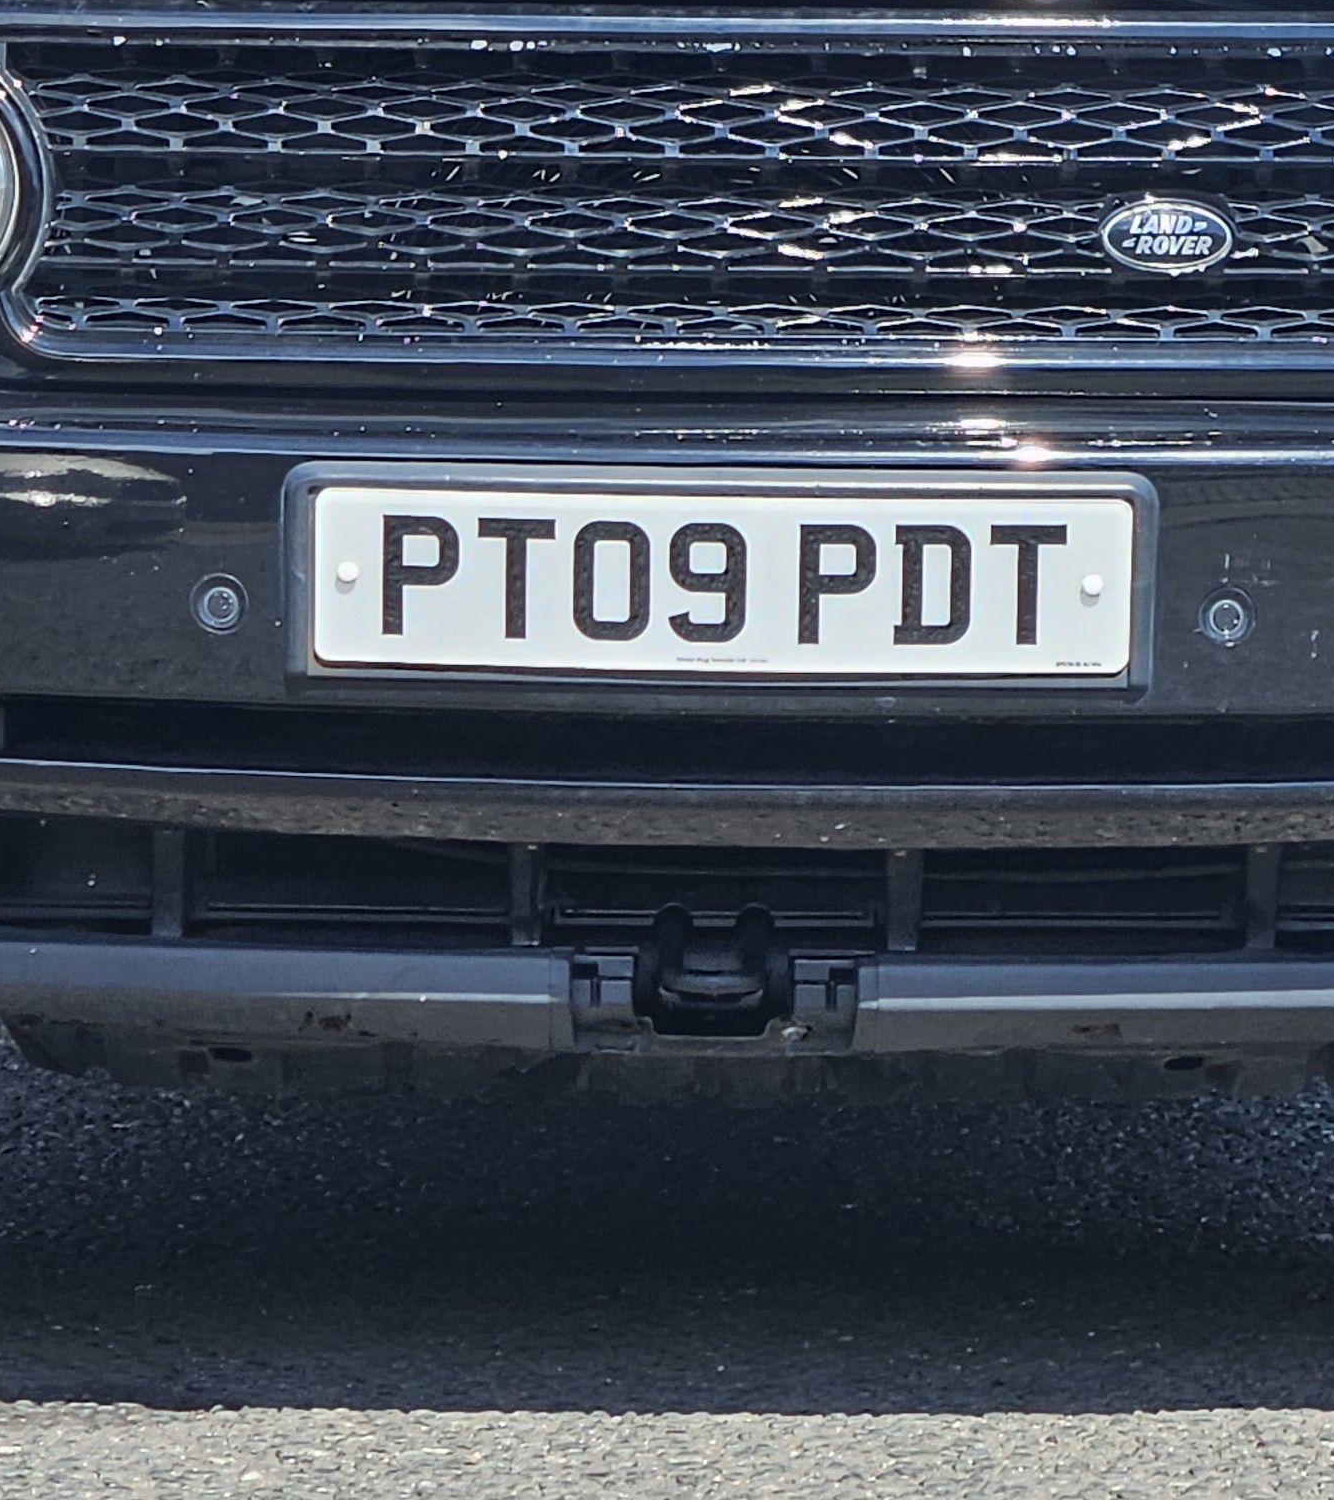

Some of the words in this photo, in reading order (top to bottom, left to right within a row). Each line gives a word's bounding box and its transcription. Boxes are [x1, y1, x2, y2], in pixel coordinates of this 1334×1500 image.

[1129, 214, 1194, 235] LAND
[1134, 234, 1213, 256] ROVER
[381, 513, 747, 644] PT09
[797, 523, 1068, 646] PDT
